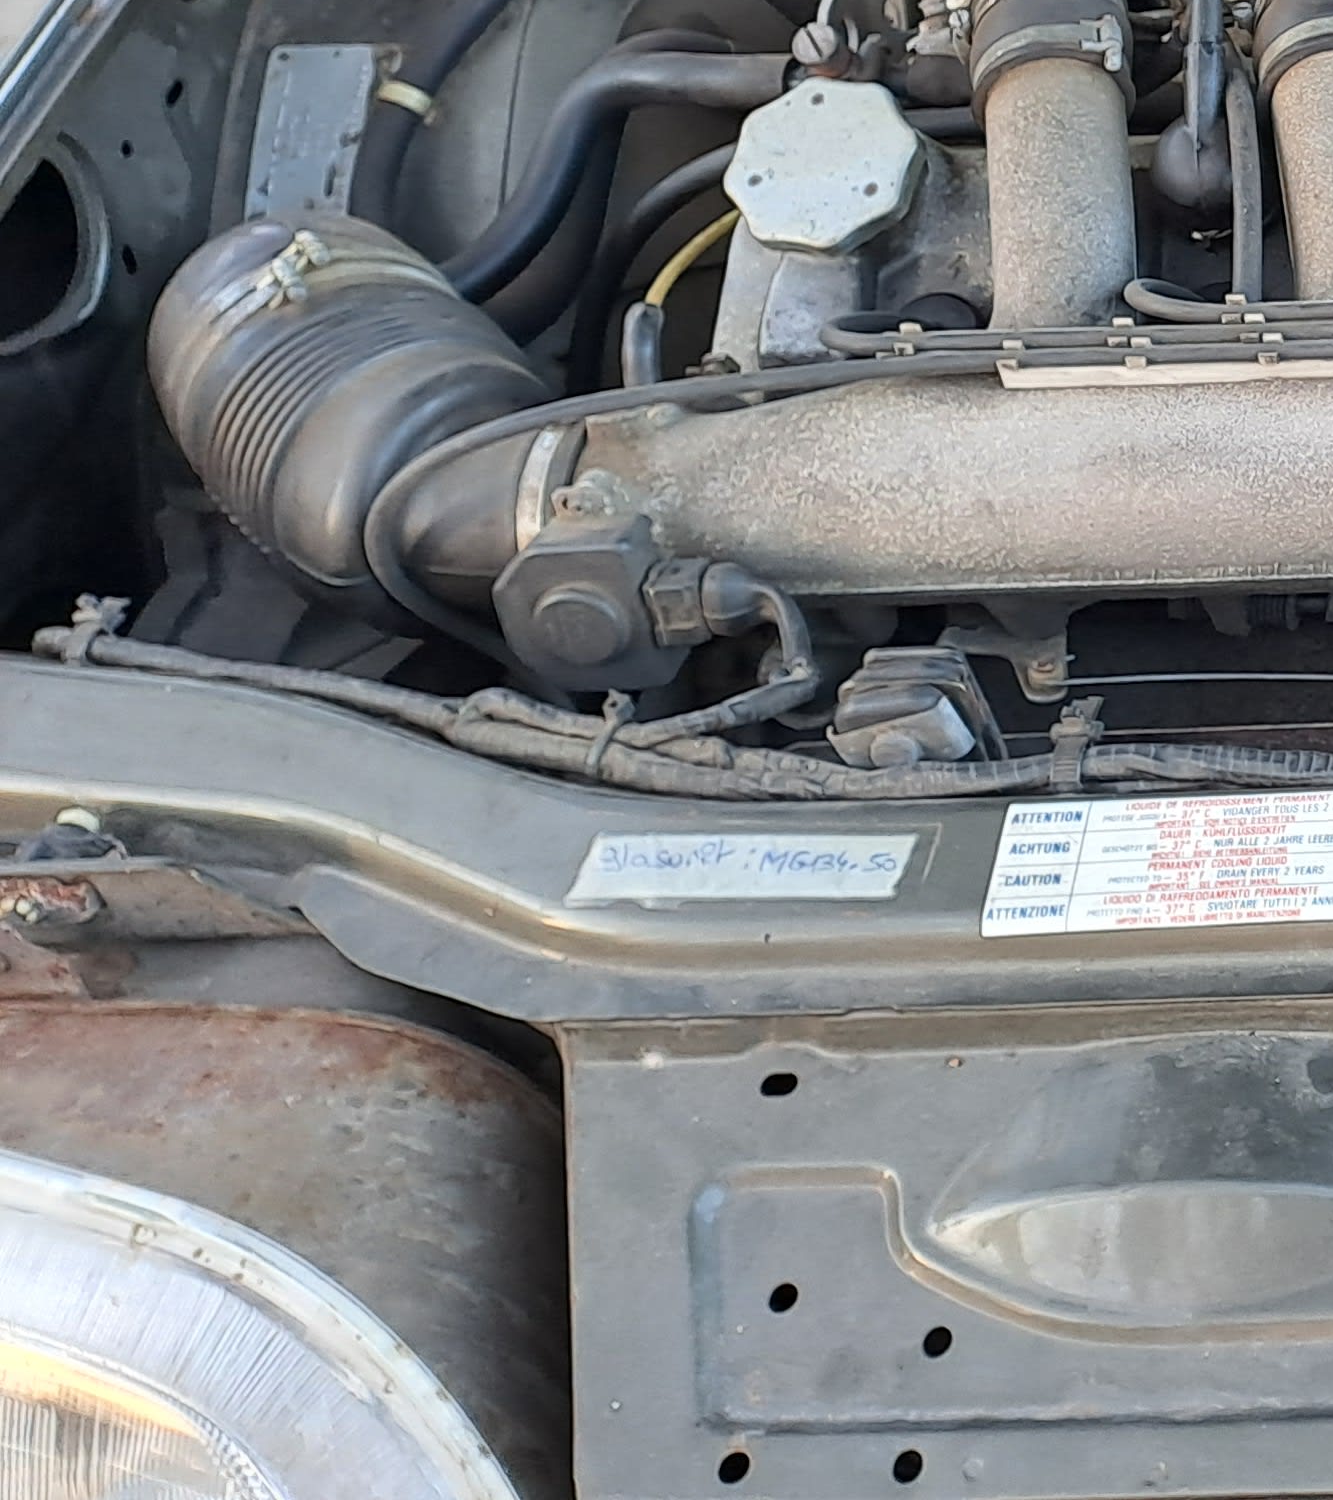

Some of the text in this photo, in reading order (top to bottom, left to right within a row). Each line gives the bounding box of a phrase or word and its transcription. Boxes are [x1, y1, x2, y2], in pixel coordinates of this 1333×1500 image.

[1273, 794, 1331, 804] PERMANENT
[1222, 806, 1270, 817] VIDANGER
[1274, 804, 1299, 814] TOUS
[1302, 803, 1319, 813] LES
[1322, 802, 1330, 812] 2
[1011, 810, 1083, 825] ATTENTION
[1159, 829, 1192, 840] DAUER
[1214, 838, 1234, 848] NUR
[1238, 836, 1259, 846] ALLE
[1263, 836, 1270, 845] 2
[1273, 835, 1304, 845] JAHRE
[1008, 841, 1071, 855] ACHTUNG
[1147, 856, 1288, 871] PERMANENT COOLING LIQUID
[1004, 873, 1062, 887] CAUTION
[1216, 868, 1247, 880] DRAIN
[1250, 867, 1281, 878] EVERY
[1283, 866, 1290, 876] 2
[1294, 865, 1325, 876] YEARS
[1103, 886, 1319, 905] LIQUIDO DI RAFFREDDAMENTO PERMANENTE
[1207, 901, 1258, 912] SVUOTARE
[1263, 898, 1291, 909] TUTTI
[1301, 897, 1308, 907] 2
[985, 904, 1066, 921] ATTENZIONE
